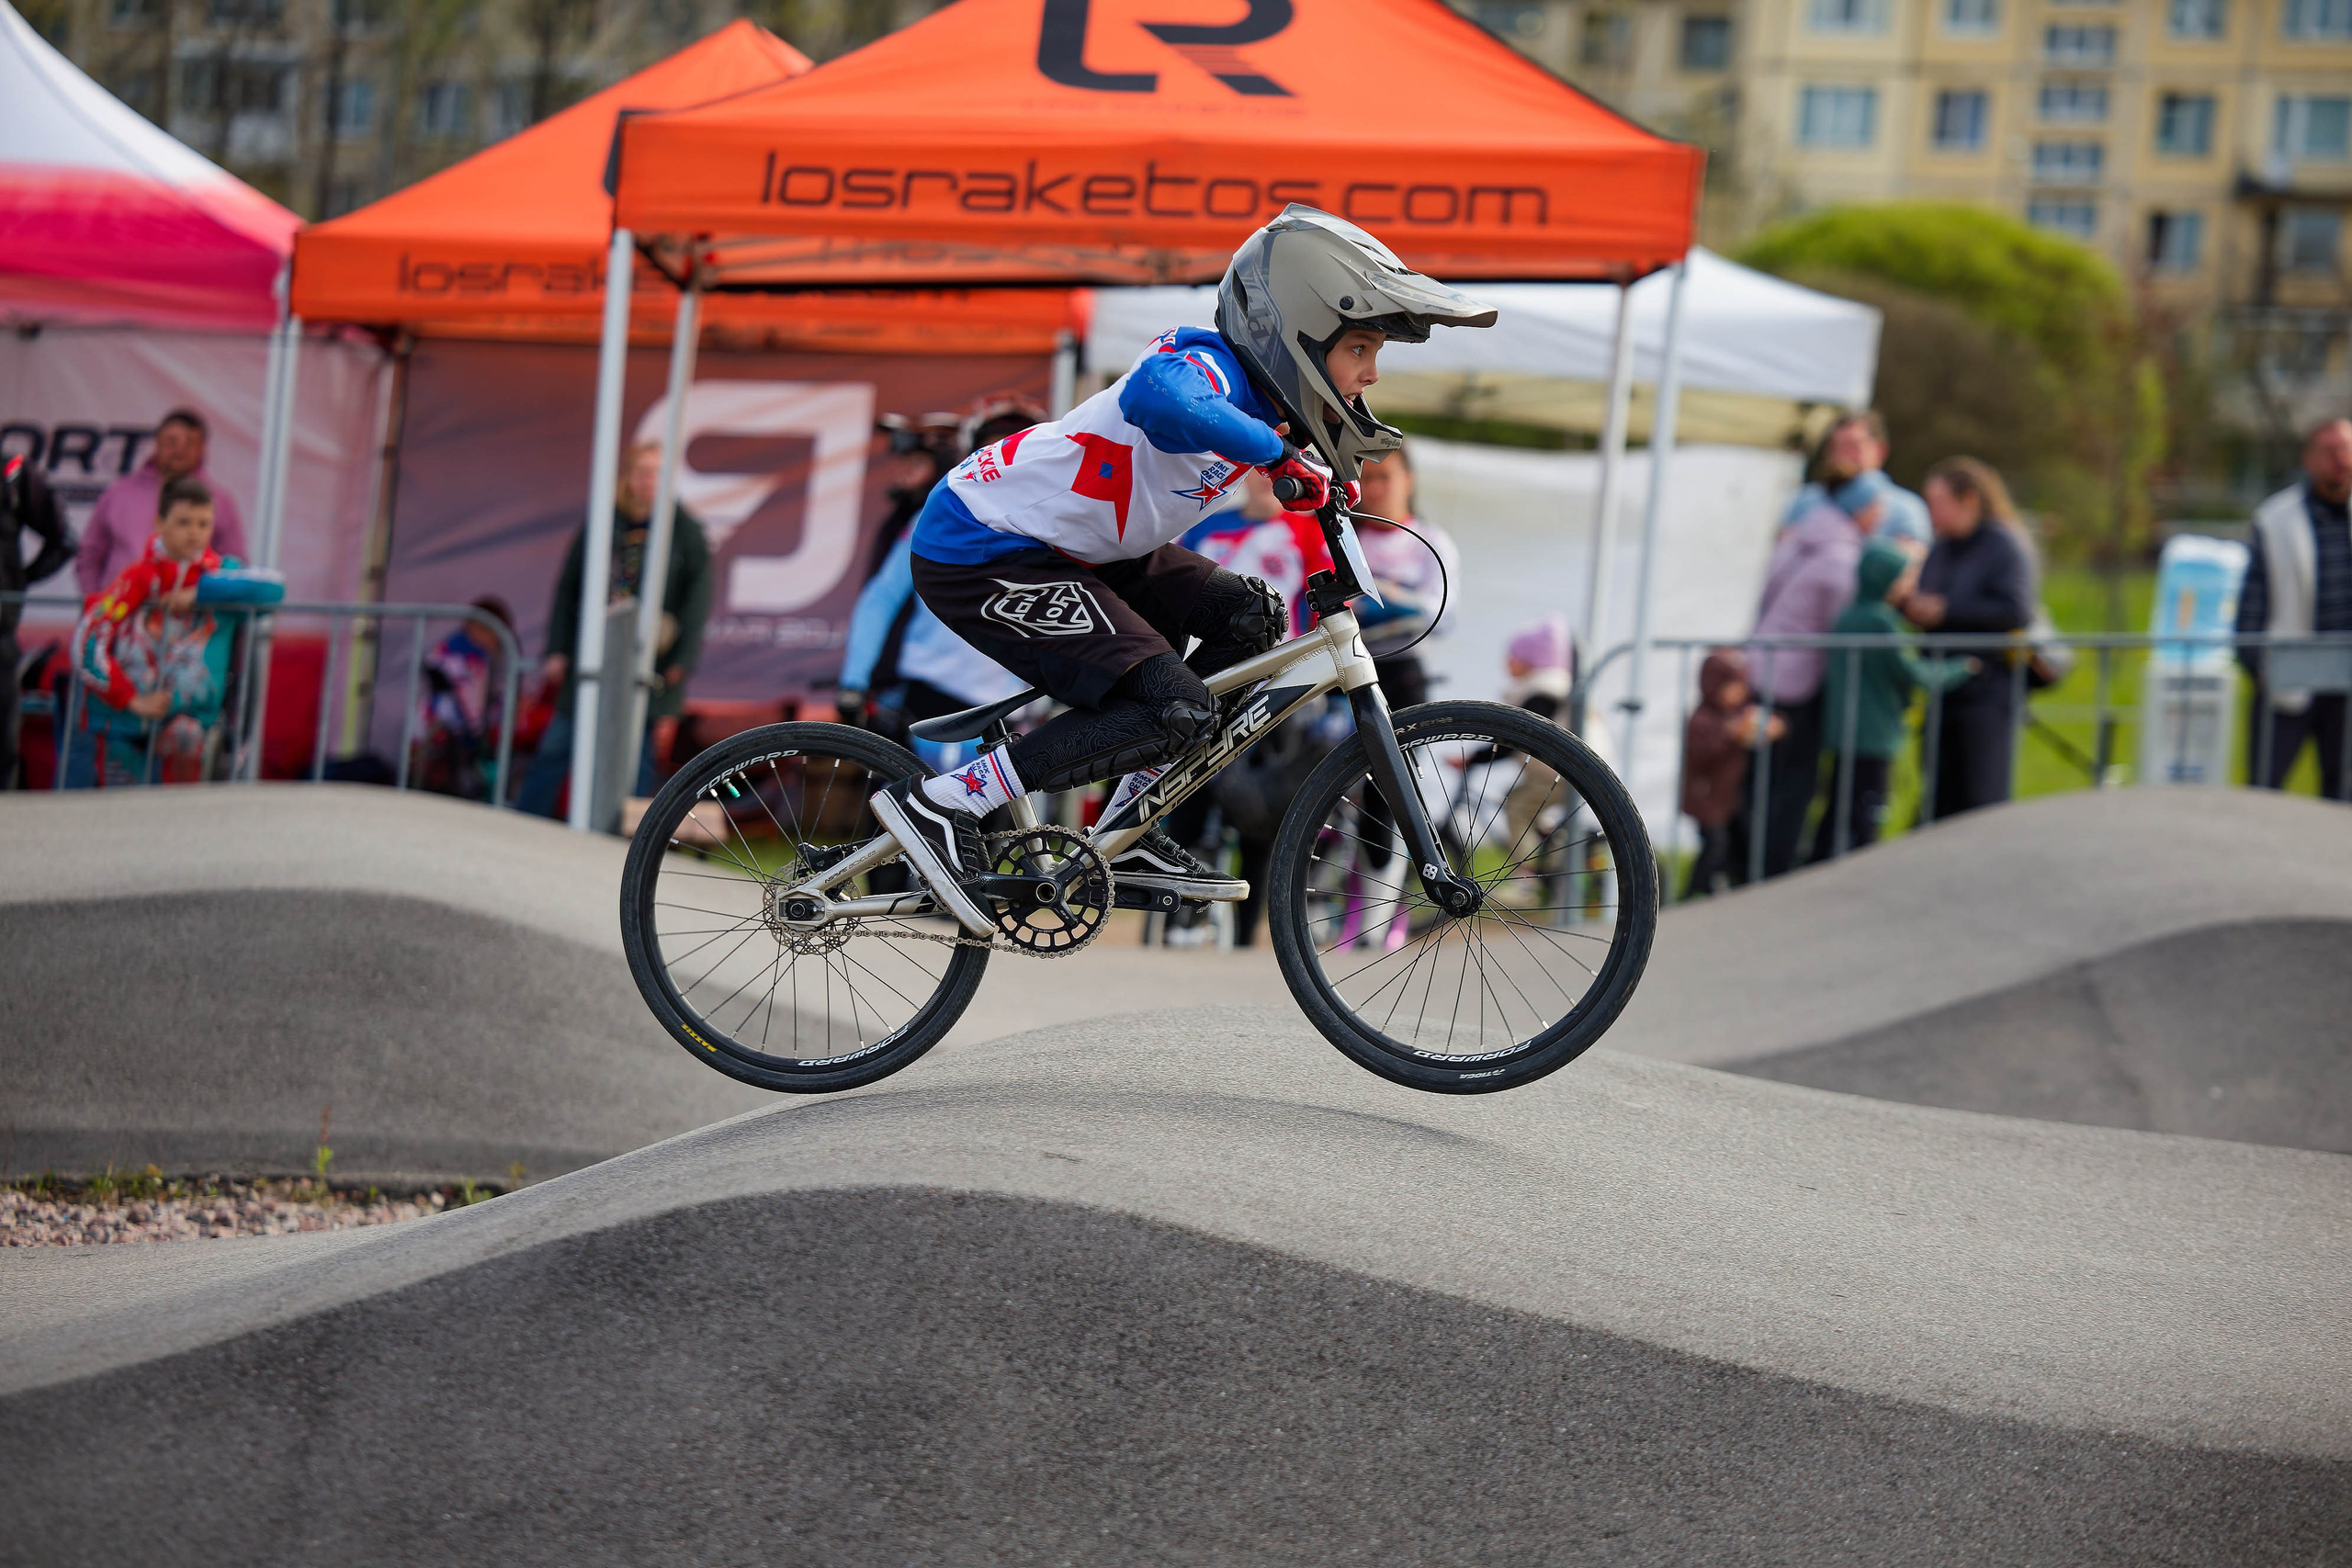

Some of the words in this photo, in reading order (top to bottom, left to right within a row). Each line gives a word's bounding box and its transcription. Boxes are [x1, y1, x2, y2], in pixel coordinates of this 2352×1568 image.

[760, 150, 1549, 227] losraketoscom
[1201, 469, 1215, 480] ON
[1207, 466, 1227, 480] RACE
[1213, 461, 1230, 474] BMX
[1399, 733, 1495, 751] ORWARD
[1138, 694, 1272, 824] INSPYRE
[695, 750, 799, 800] FORWARD
[1131, 776, 1148, 788] RAC
[1135, 772, 1154, 784] BMX
[797, 1023, 910, 1066] FORWARD
[1412, 1039, 1533, 1063] FORWARD
